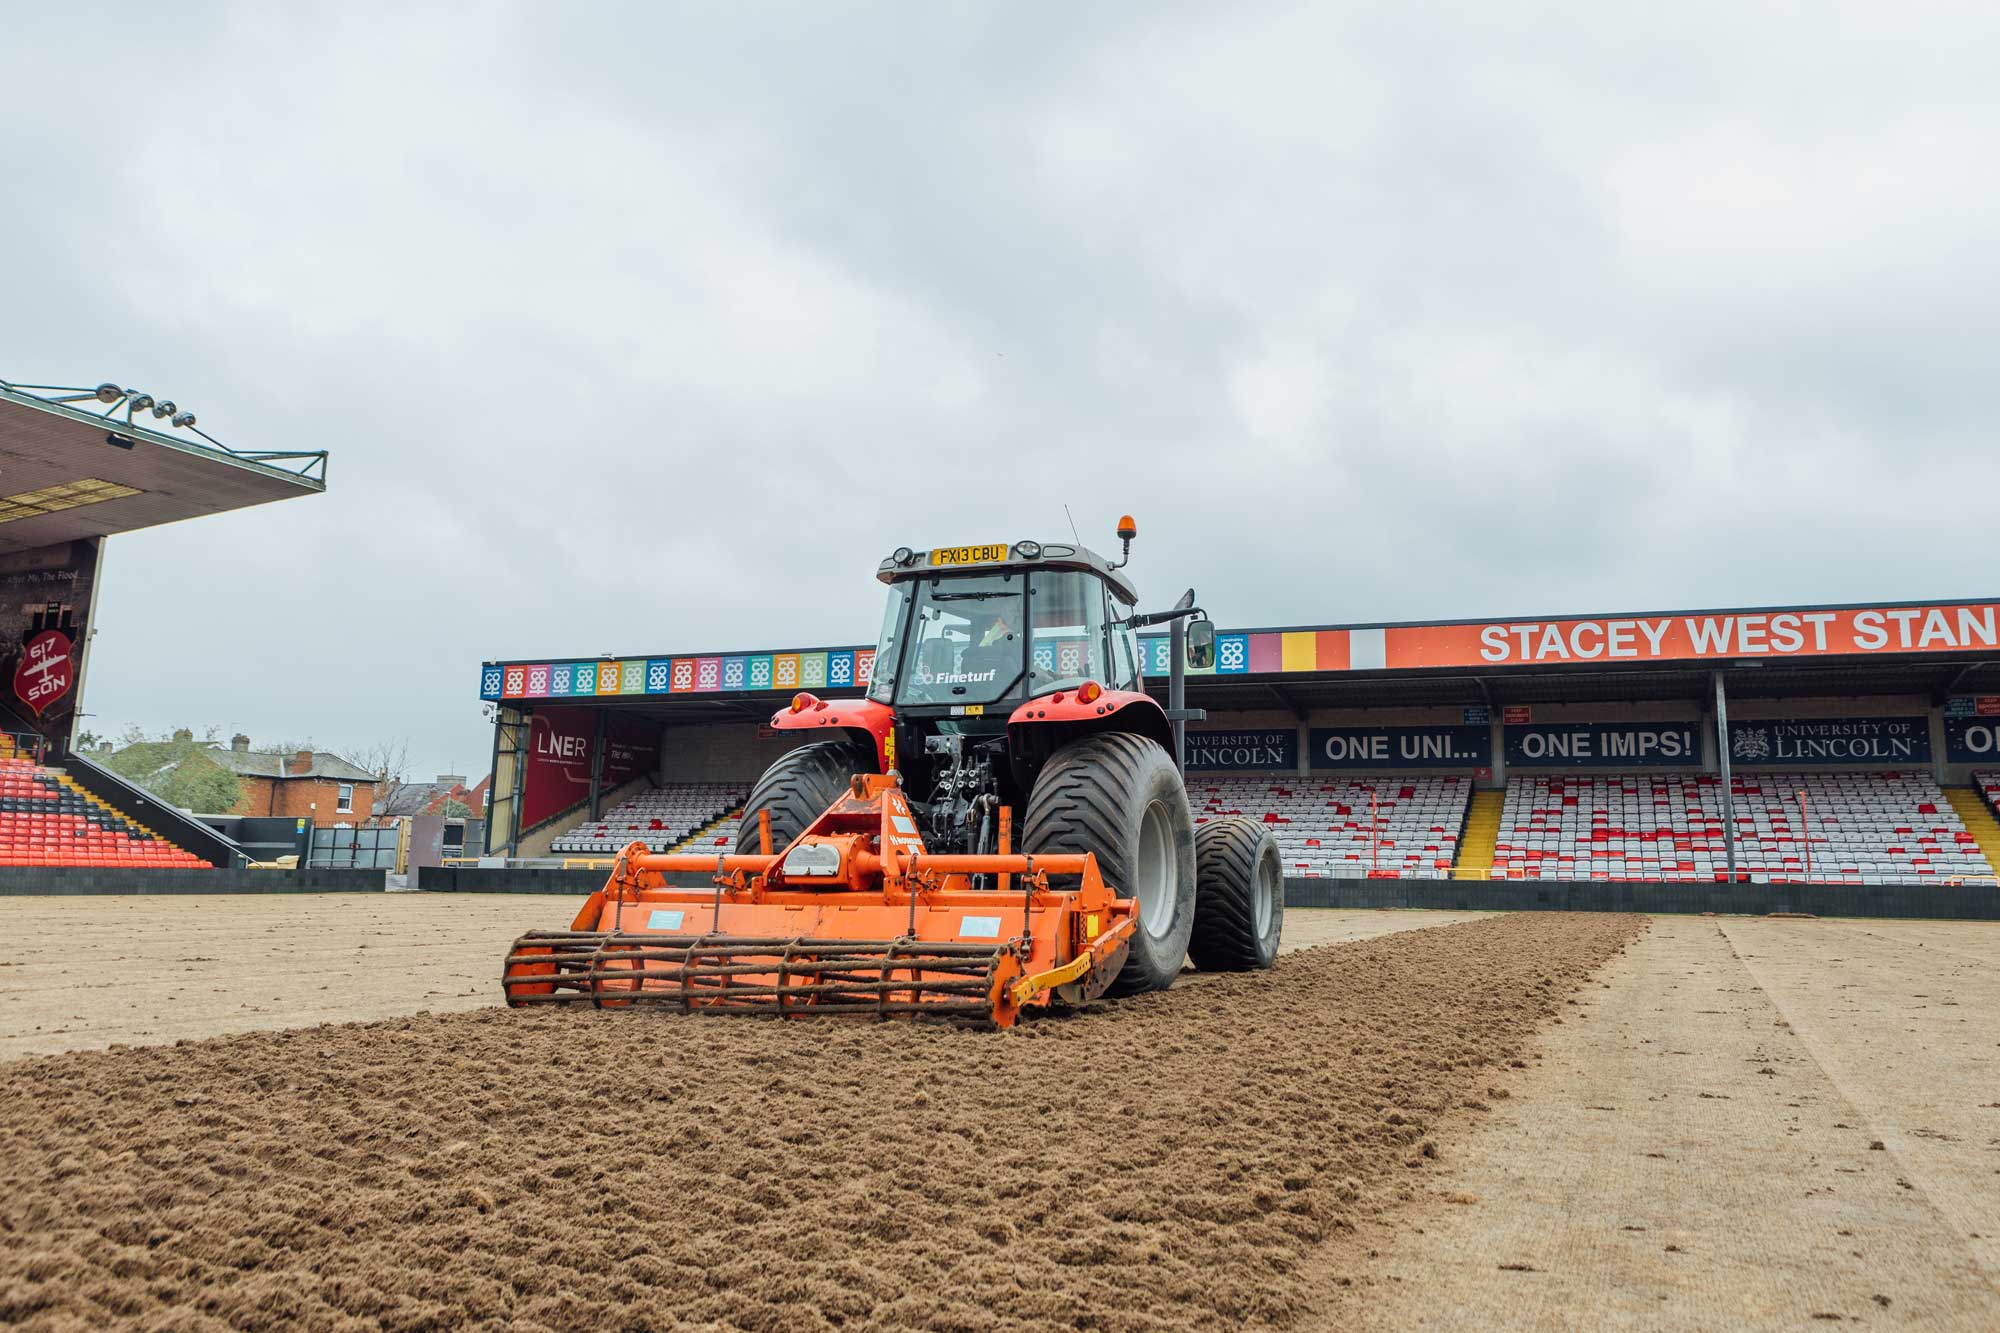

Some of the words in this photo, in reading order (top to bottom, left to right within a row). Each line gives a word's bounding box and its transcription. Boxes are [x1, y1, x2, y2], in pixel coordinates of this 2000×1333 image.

[940, 548, 969, 563] FX13
[973, 546, 999, 560] CBU
[1480, 619, 1672, 661] STACEY
[1685, 613, 1836, 654] WEST
[30, 637, 57, 659] 617
[936, 669, 996, 684] Fineturf
[1186, 735, 1259, 746] NIVERSITY
[1265, 734, 1284, 745] OF
[1774, 724, 1881, 736] UNIVERSITY
[1888, 723, 1911, 734] OF
[537, 730, 586, 758] LNER
[1325, 736, 1390, 761] ONE
[1400, 735, 1478, 759] UNI...
[1522, 732, 1592, 758] ONE
[1600, 731, 1692, 757] IMPS!
[1775, 738, 1912, 758] LINCOLN
